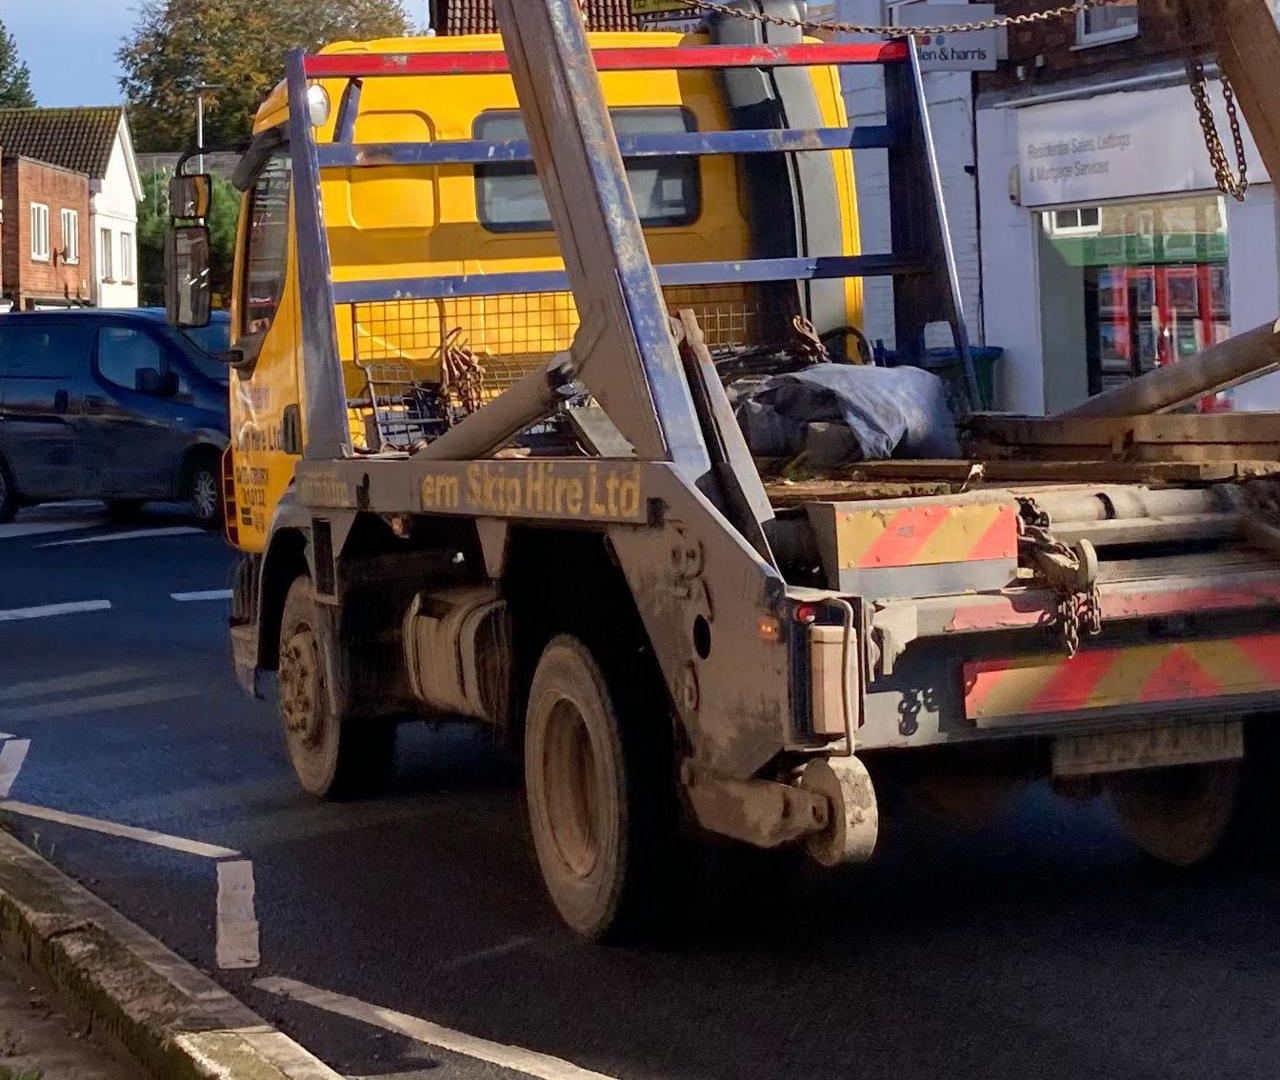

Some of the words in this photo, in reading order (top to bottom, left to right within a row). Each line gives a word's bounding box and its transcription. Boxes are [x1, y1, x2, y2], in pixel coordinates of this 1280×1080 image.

[951, 47, 987, 60] harris
[526, 463, 583, 514] Hire
[589, 463, 641, 517] Ltd
